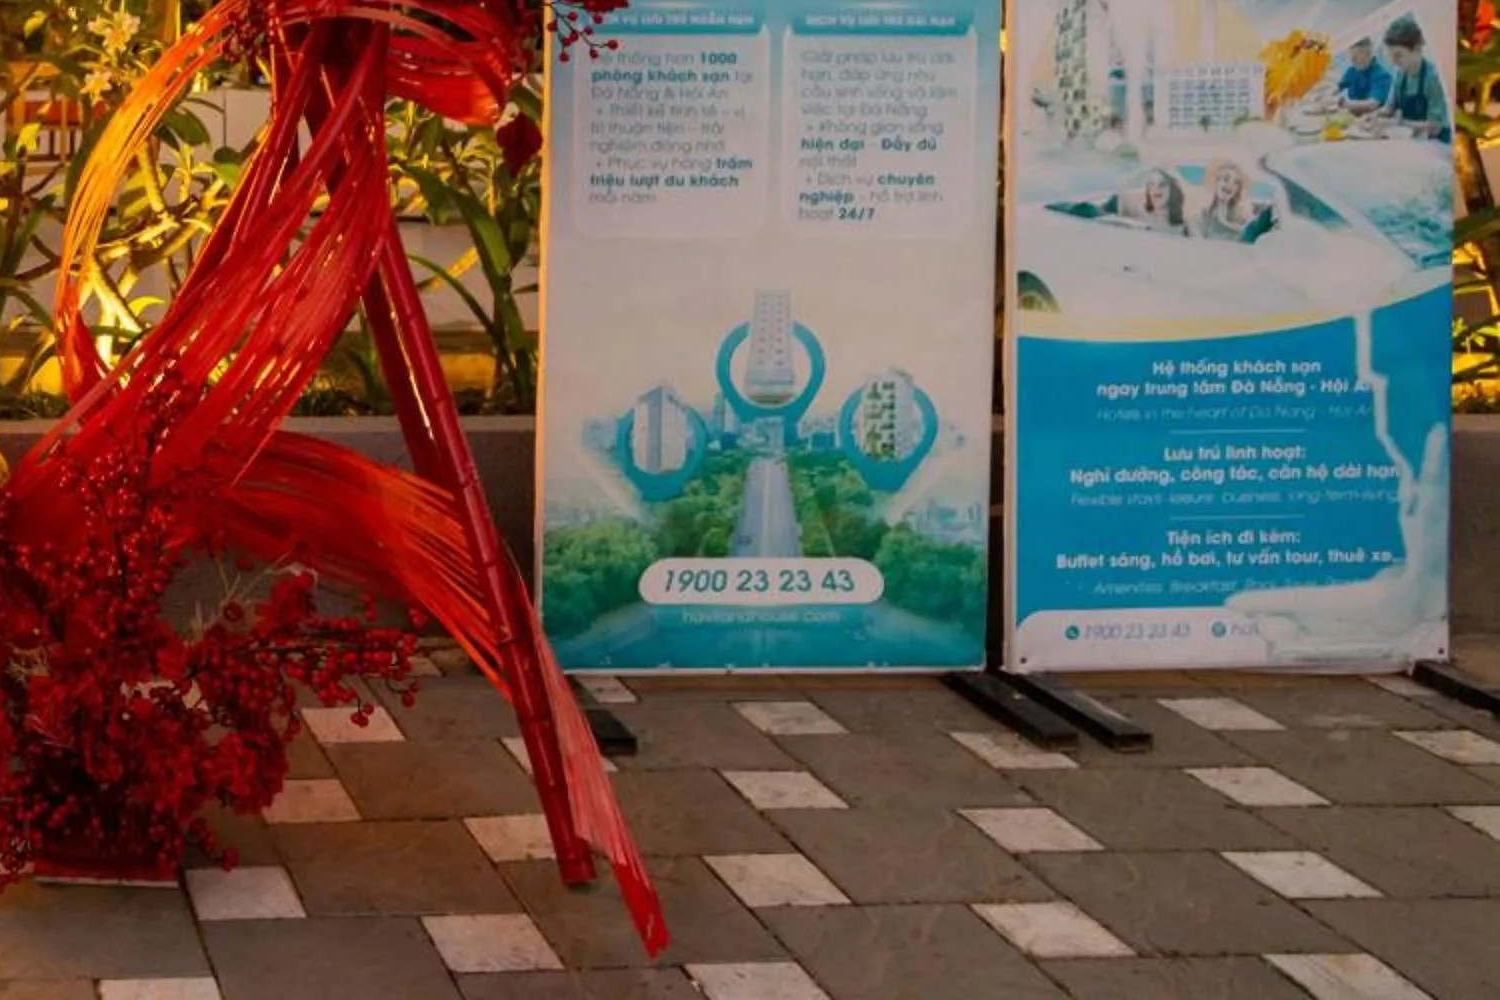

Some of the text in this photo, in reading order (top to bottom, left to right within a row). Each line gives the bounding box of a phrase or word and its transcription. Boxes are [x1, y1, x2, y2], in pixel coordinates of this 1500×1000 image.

[701, 51, 738, 65] 1000
[591, 68, 643, 86] phòng
[647, 67, 698, 83] khách
[663, 172, 686, 187] du
[689, 172, 740, 188] khách
[1152, 358, 1322, 379] Hệ thống khách sạn
[1096, 382, 1141, 401] ngay
[1144, 381, 1189, 399] trung
[1230, 379, 1256, 396] Đà
[1259, 376, 1307, 398] Nẵng
[1320, 377, 1350, 397] Hội
[1164, 446, 1194, 462] Lưu
[1225, 445, 1257, 461] linh
[1180, 465, 1226, 485] công
[1333, 461, 1363, 480] dài
[1366, 463, 1400, 482] hạn
[1165, 530, 1202, 549] Tiện
[1206, 528, 1233, 545] ích
[1236, 528, 1255, 545] đi
[1056, 554, 1106, 570] Buffet
[1328, 546, 1366, 563] thuê
[664, 568, 857, 594] 1900 23 23 43
